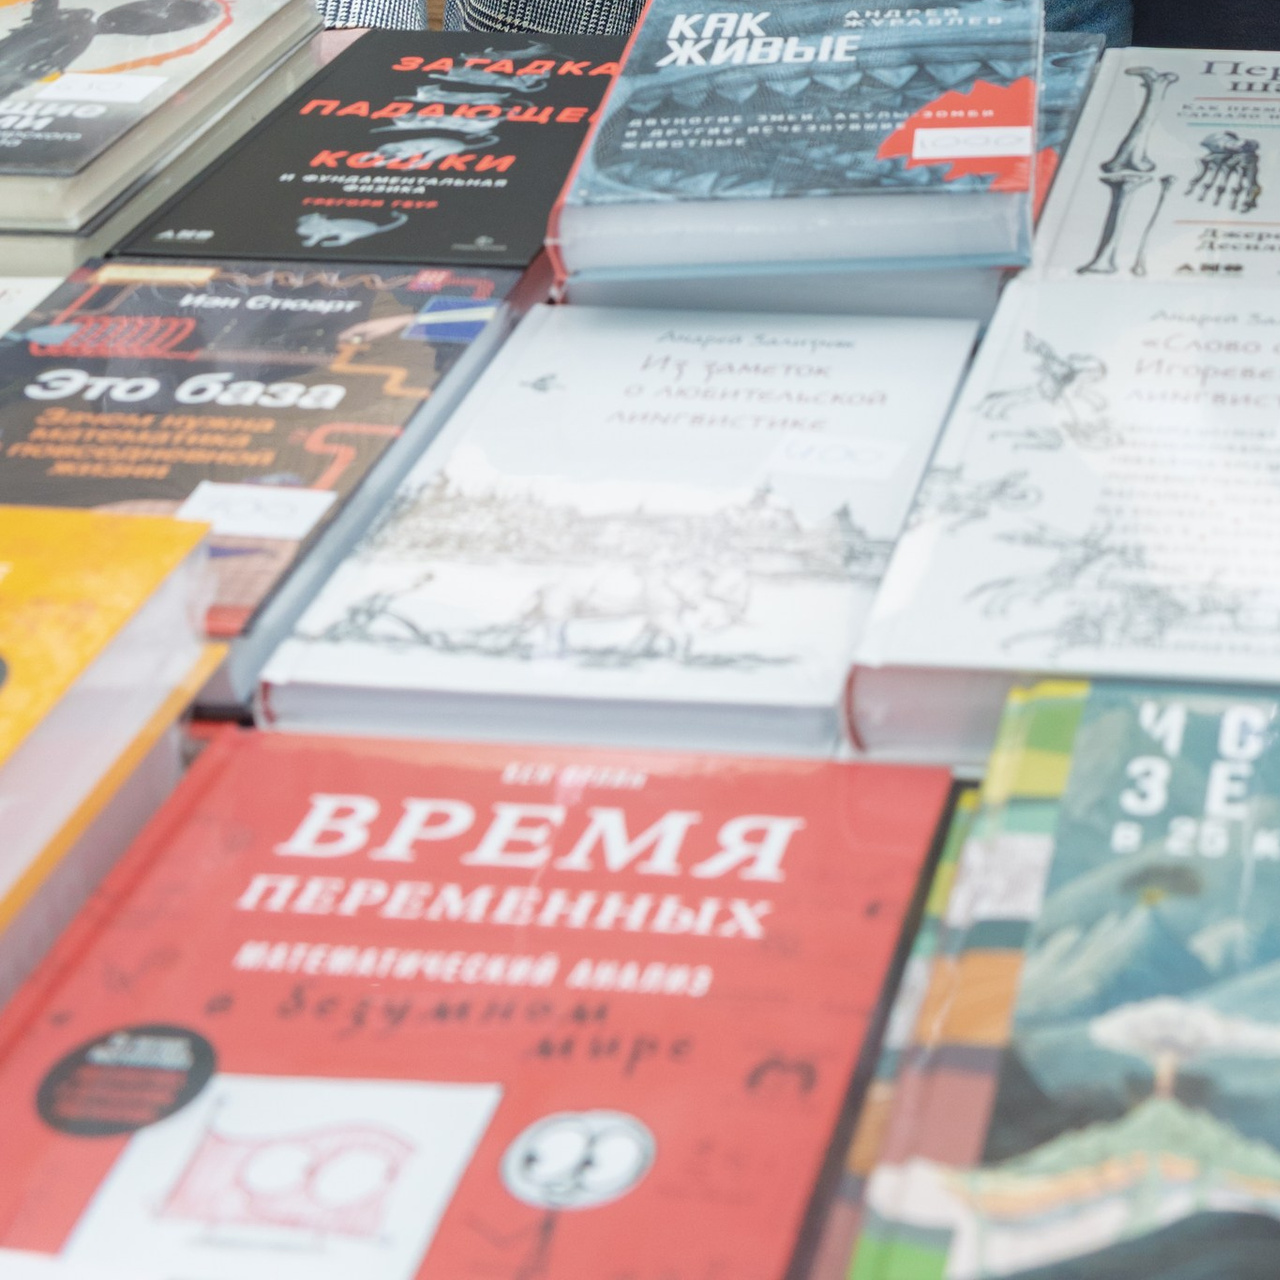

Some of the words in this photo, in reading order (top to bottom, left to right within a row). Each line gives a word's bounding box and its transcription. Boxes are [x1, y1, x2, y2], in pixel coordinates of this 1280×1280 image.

[667, 11, 772, 40] КАК
[655, 34, 863, 67] ЖИВЫЕ
[391, 56, 622, 77] ЗАГАДКА
[309, 149, 518, 173] КОШКИ
[279, 172, 296, 183] И
[302, 172, 508, 188] ФУНДАМЕНТАЛЬНАЯ
[342, 183, 426, 195] ФИЗИКА
[179, 293, 242, 309] Иэн
[245, 294, 362, 315] Стюарт
[24, 368, 162, 404] Это
[173, 372, 348, 411] база
[272, 791, 807, 883] ВРЕМЯ
[232, 872, 775, 941] ПЕРЕМЕННЫХ
[232, 939, 560, 988] МАТЕМАТИЧЕСКИЙ
[566, 958, 715, 998] АНАЛИЗ
